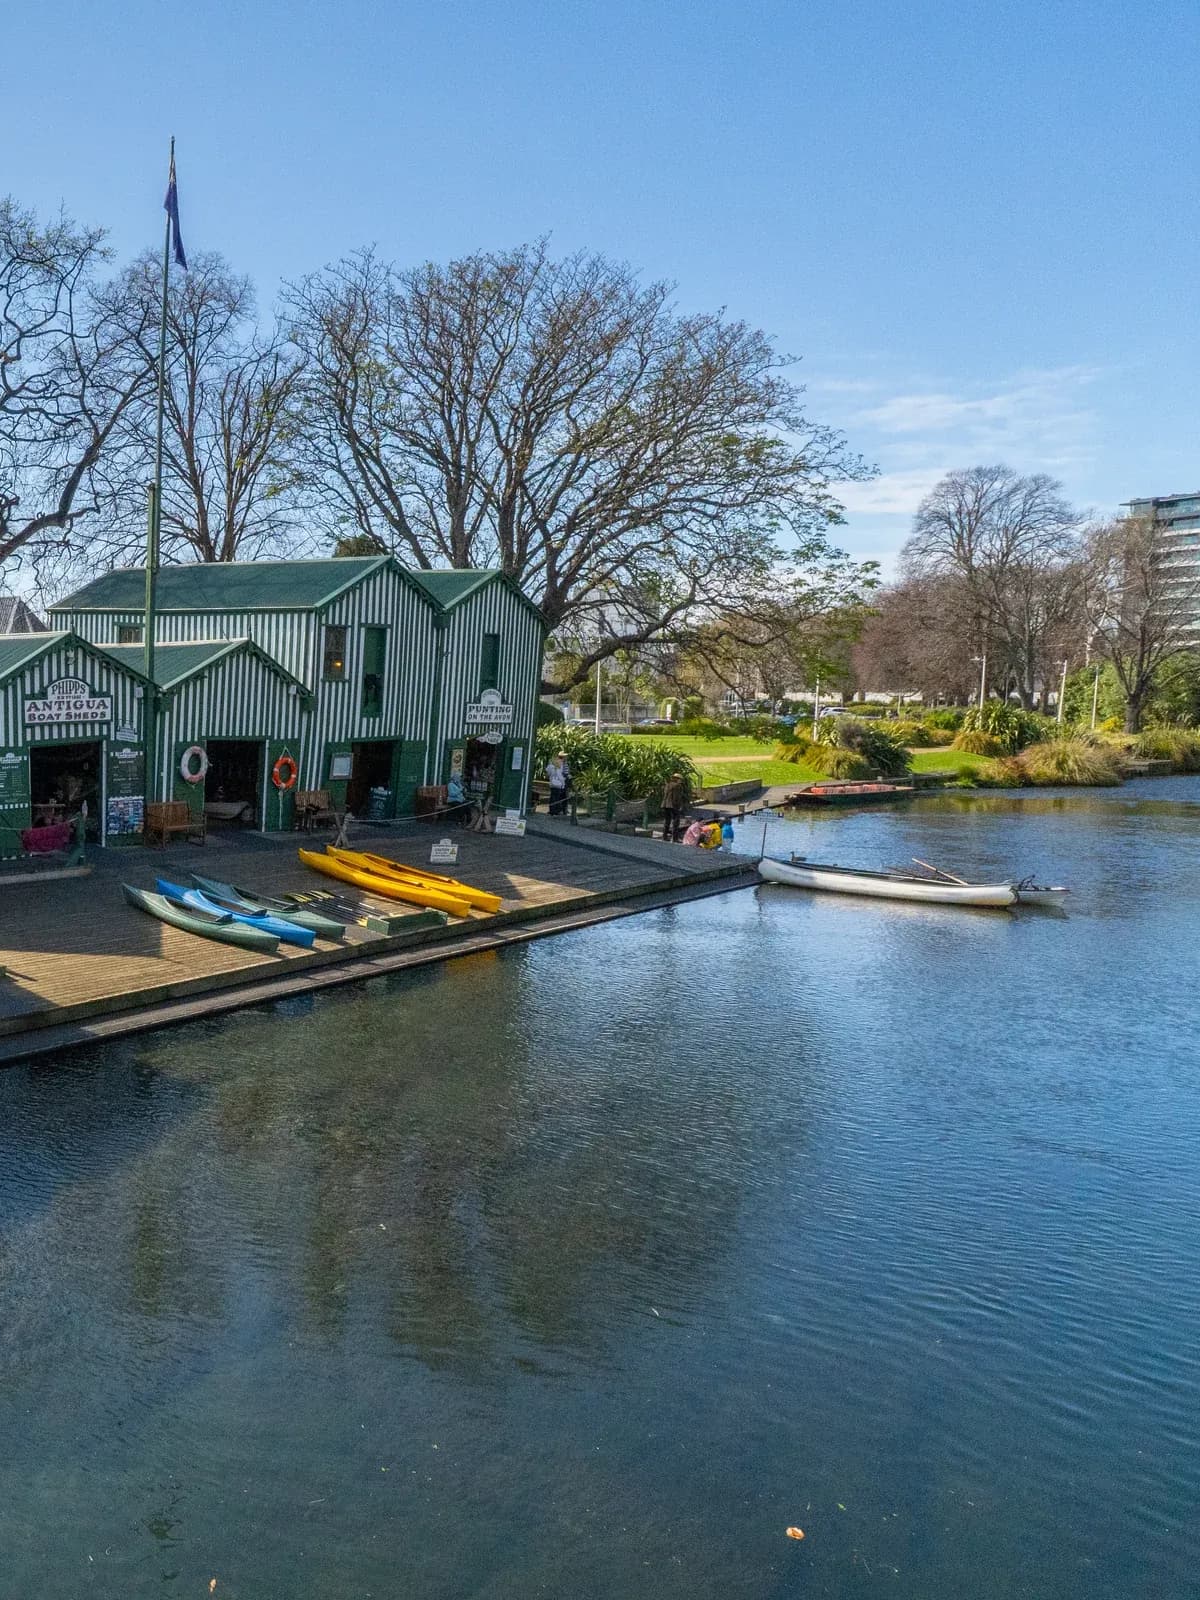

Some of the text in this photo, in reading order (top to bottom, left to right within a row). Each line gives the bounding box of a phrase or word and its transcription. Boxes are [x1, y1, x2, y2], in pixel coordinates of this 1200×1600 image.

[51, 680, 86, 695] PHIPPS
[26, 699, 109, 712] ANTIGUA
[468, 705, 511, 713] PUNTING
[28, 711, 106, 722] BOAT SHEDS
